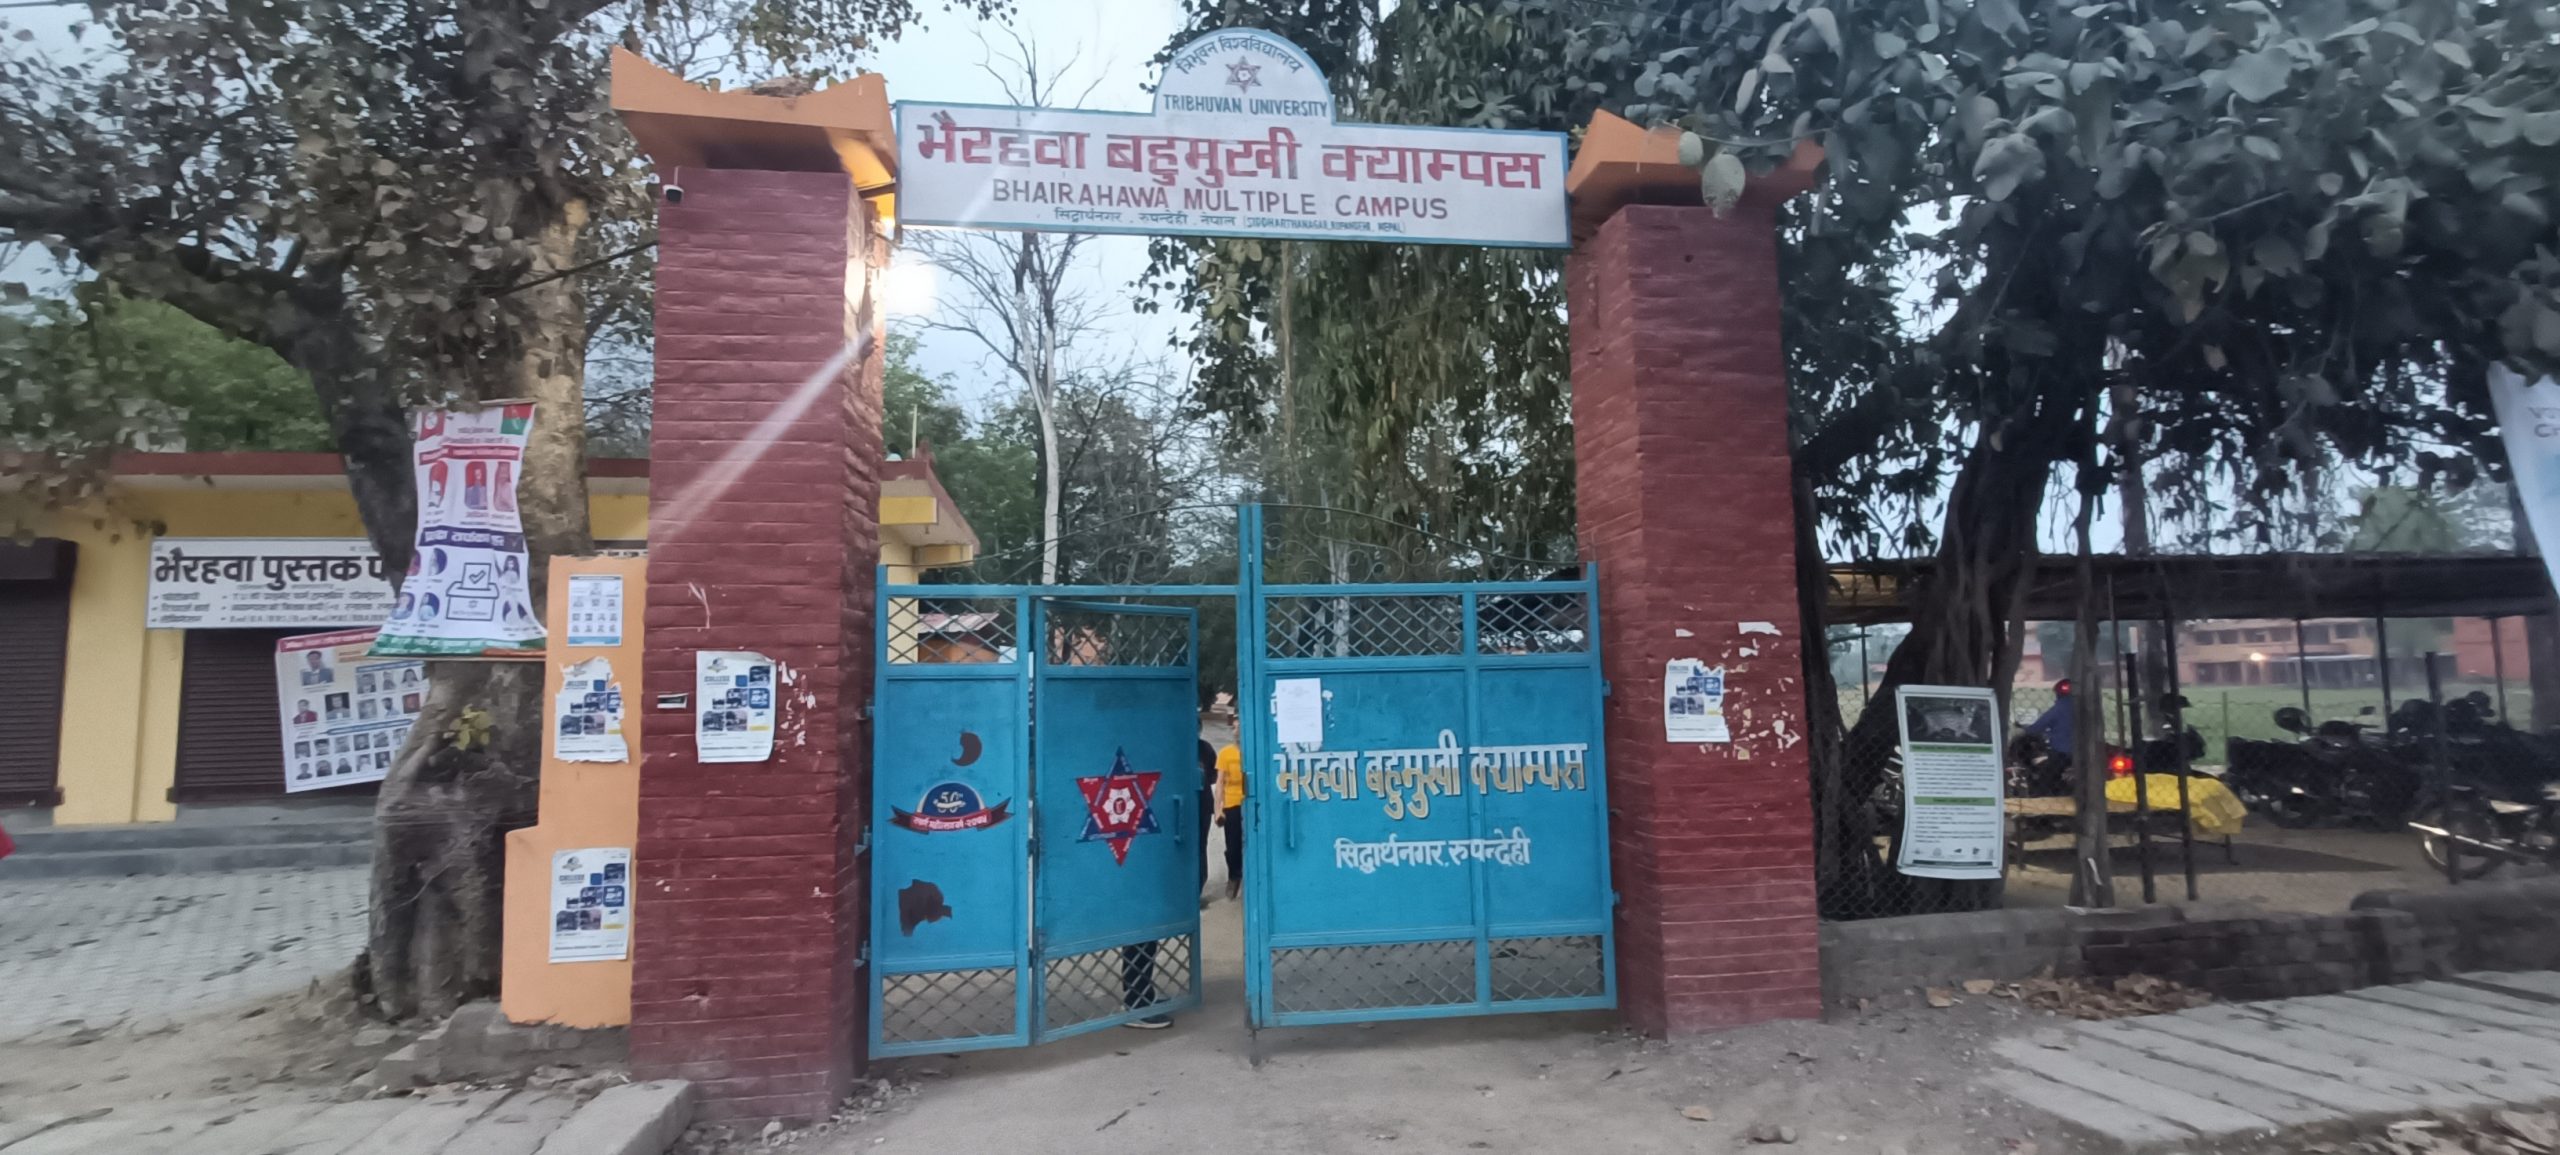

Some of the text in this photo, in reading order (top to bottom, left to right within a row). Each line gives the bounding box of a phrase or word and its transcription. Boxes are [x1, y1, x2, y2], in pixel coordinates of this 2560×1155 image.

[1175, 35, 1304, 75] त्रिभुवन विश्वविद्यालय
[1163, 94, 1328, 118] TRIBHUVAN UNIVERSITY
[916, 110, 1546, 190] भैरहवा बहुमुखी क्याम्पस
[992, 178, 1448, 220] BHAIRAHAWA MULTIPLE CAMPUS
[155, 547, 257, 585] भैरहवा
[260, 555, 362, 592] पुस्तक
[1363, 729, 1463, 820] बहुमुखी
[1469, 743, 1588, 795] क्याम्पस
